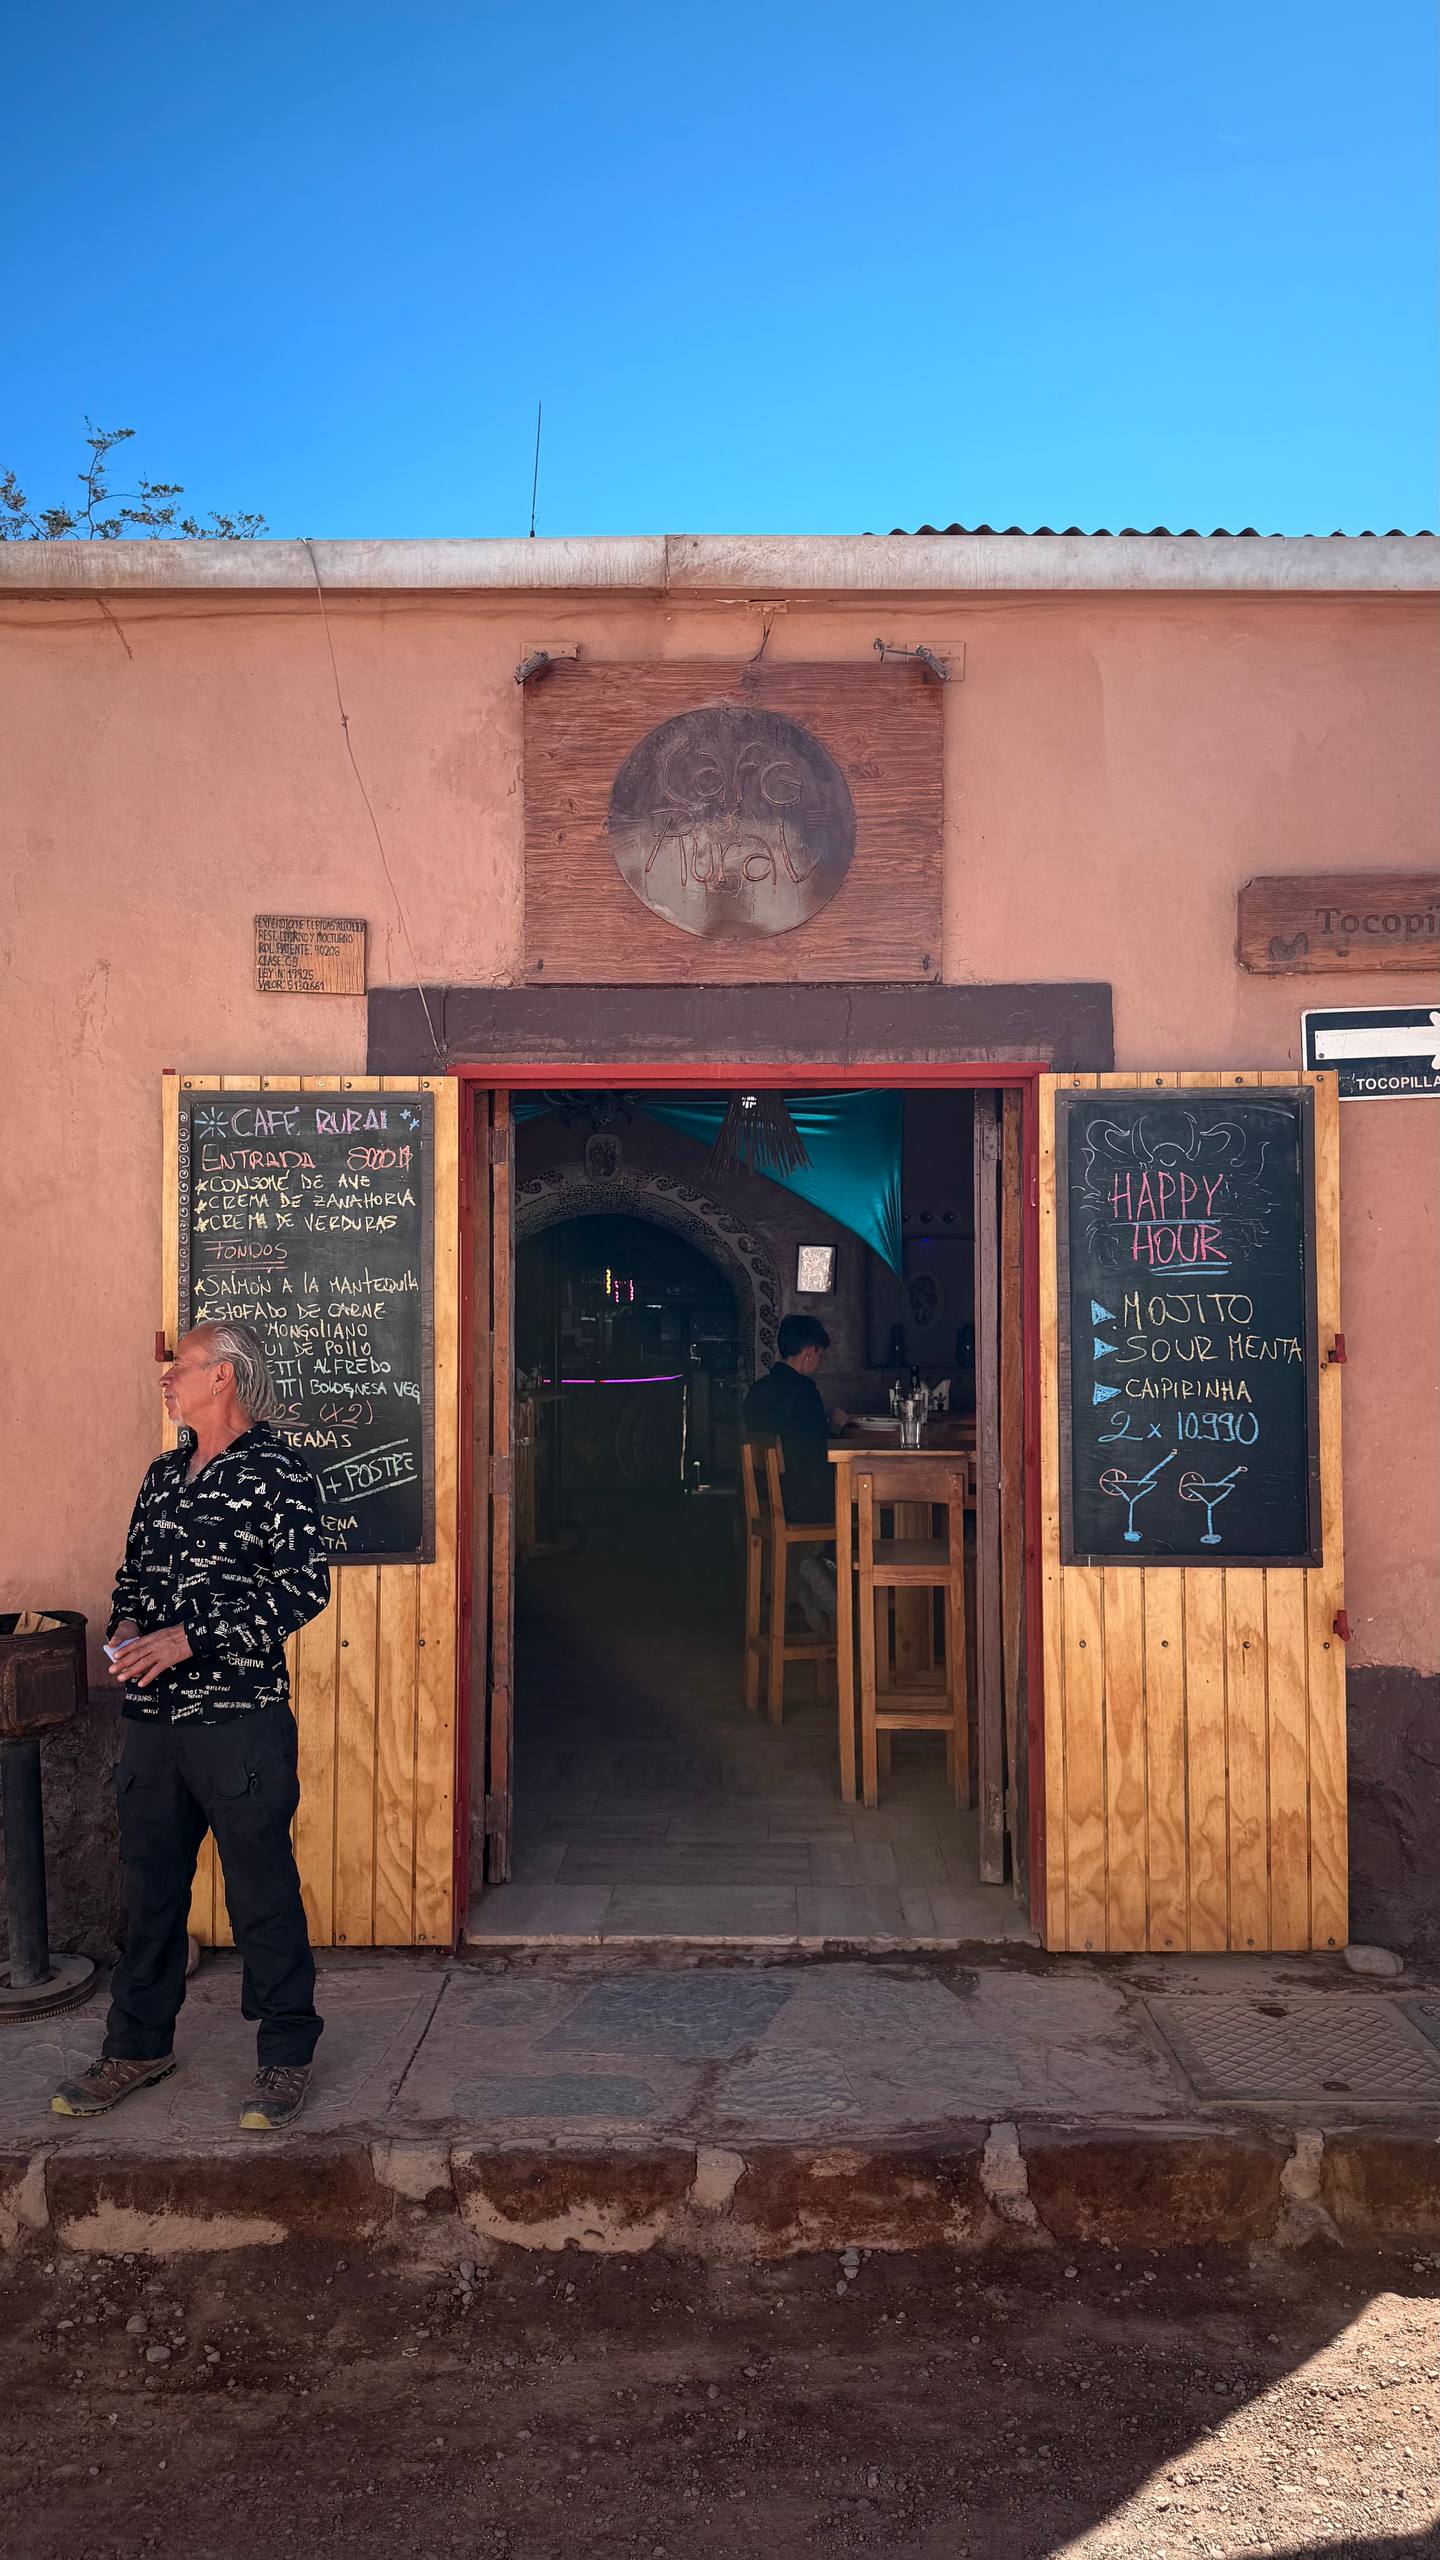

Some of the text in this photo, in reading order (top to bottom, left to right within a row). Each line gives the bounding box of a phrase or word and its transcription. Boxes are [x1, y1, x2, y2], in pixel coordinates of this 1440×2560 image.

[645, 809, 820, 887] Rural
[1315, 906, 1440, 941] Tocopi
[315, 1107, 388, 1136] RURAL
[201, 1143, 317, 1171] ENTRADA
[300, 1174, 324, 1190] DE
[337, 1173, 371, 1191] AVE
[1109, 1171, 1224, 1221] HAPPY
[208, 1188, 417, 1211] CREMA DE ZANAHORIA
[208, 1212, 398, 1233] CREMA DE VERDURAS
[1131, 1223, 1228, 1265] HOUR
[282, 1277, 294, 1294] A
[296, 1303, 321, 1320] DE
[328, 1301, 385, 1320] CARNE
[1123, 1290, 1254, 1331] MOJITO
[293, 1341, 315, 1358] DE
[1115, 1333, 1303, 1364] SOUR MENTA
[313, 1356, 392, 1376] ALFREDO
[1125, 1377, 1253, 1404] CAIPIRINHA
[283, 1429, 352, 1449] TEADAS
[1097, 1410, 1144, 1444] 2
[344, 1452, 415, 1493] POSTRE
